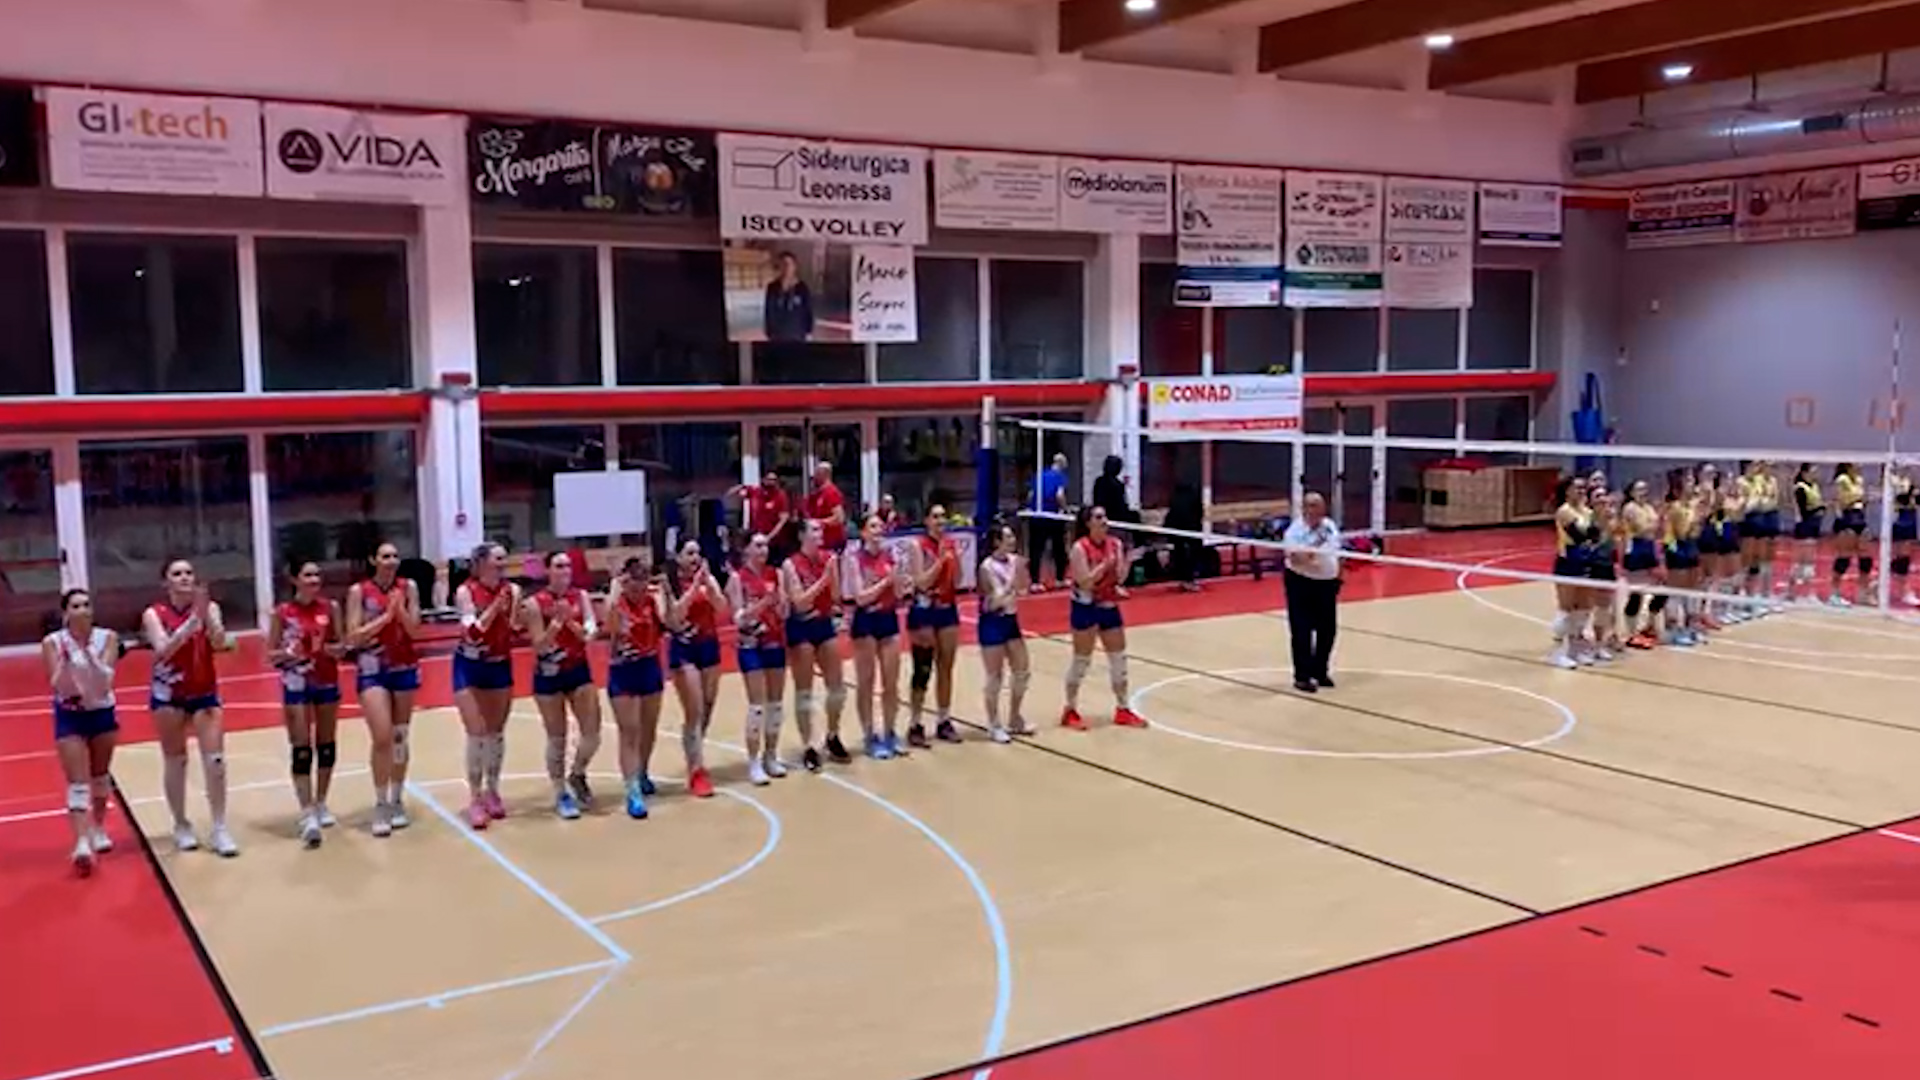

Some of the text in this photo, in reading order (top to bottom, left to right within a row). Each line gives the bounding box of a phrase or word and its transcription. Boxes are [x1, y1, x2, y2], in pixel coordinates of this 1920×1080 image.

[326, 131, 442, 168] VIDA
[797, 147, 910, 178] Siderurgica
[475, 140, 591, 197] Margarita
[801, 174, 892, 201] Leonessa
[1067, 172, 1167, 193] mediolanum
[741, 214, 905, 237] ISEO VOLLEY
[1170, 384, 1232, 402] CONAD
